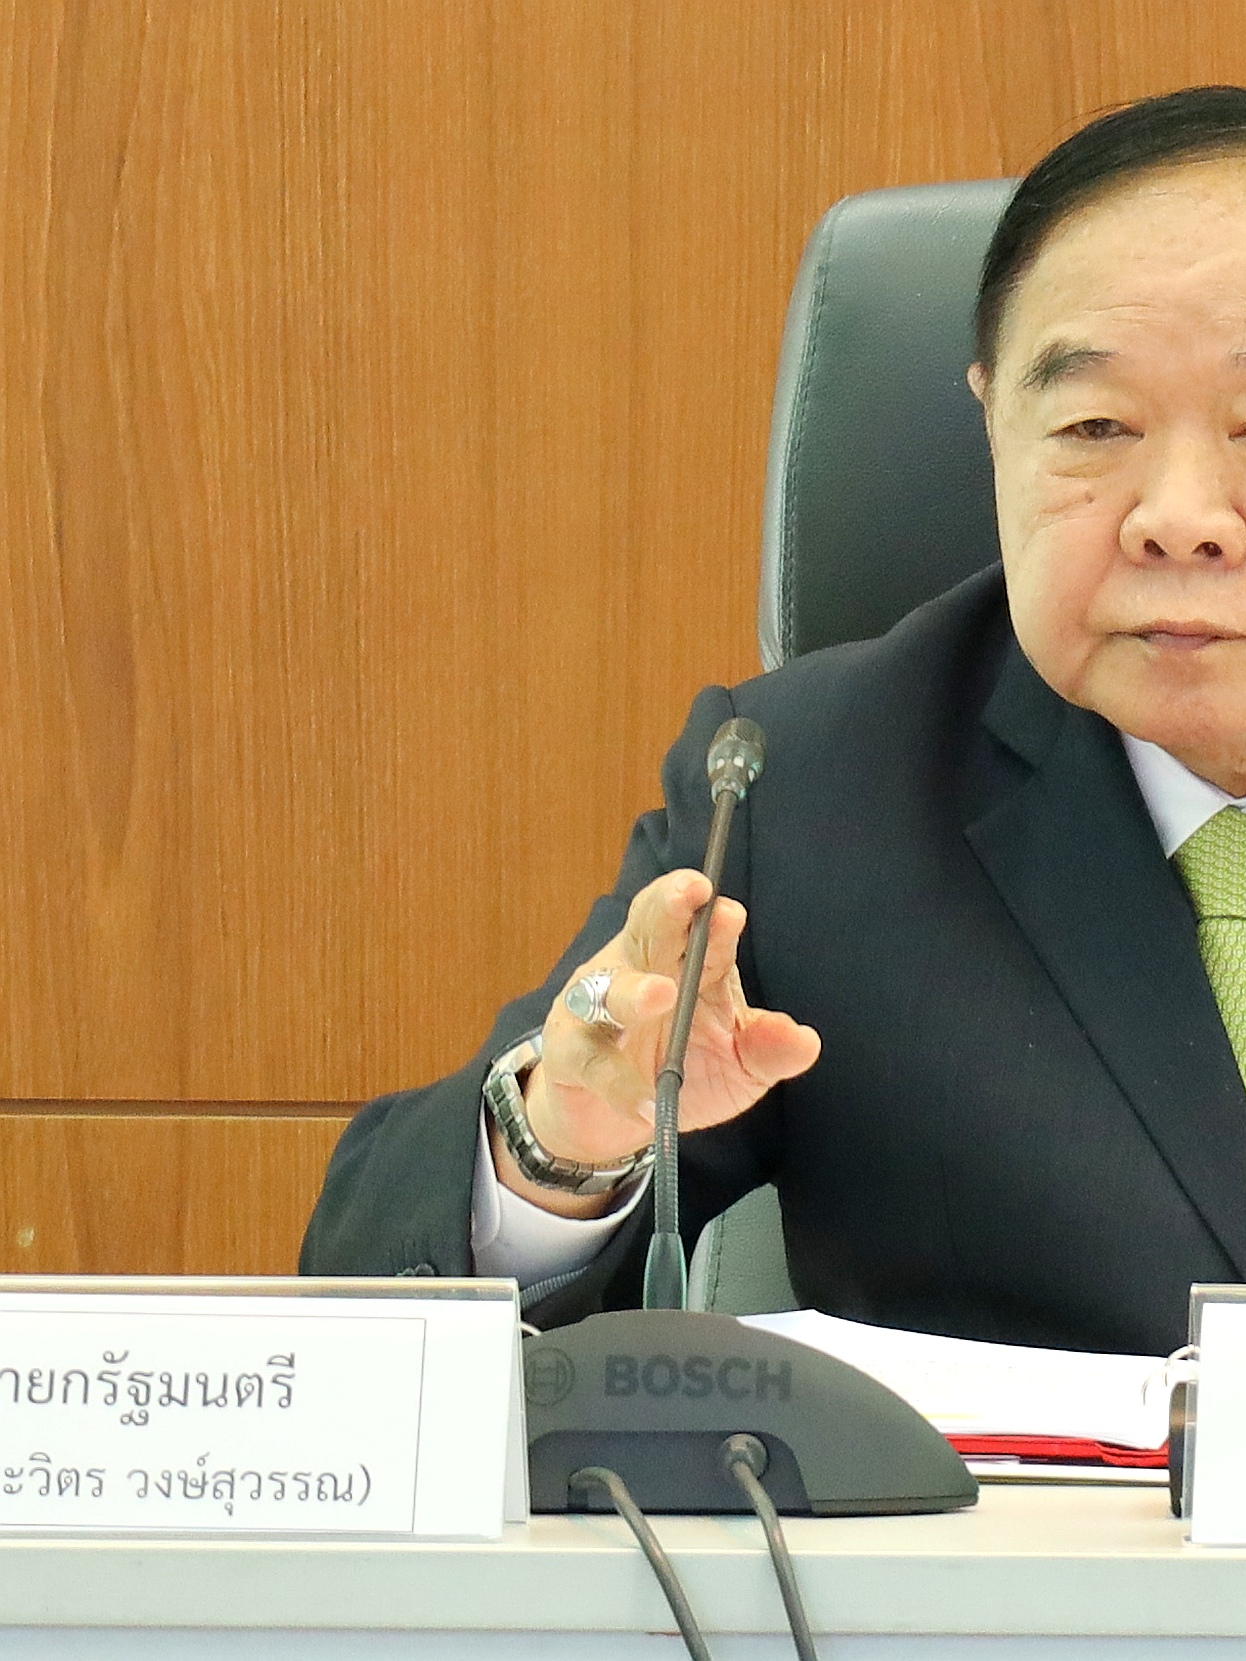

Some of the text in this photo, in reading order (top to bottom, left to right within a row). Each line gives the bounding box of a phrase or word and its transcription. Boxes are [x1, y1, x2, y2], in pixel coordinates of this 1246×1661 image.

[604, 1354, 793, 1402] BOSCH
[3, 1452, 371, 1517] ะวิตร วงษ์สุวรรณ)
